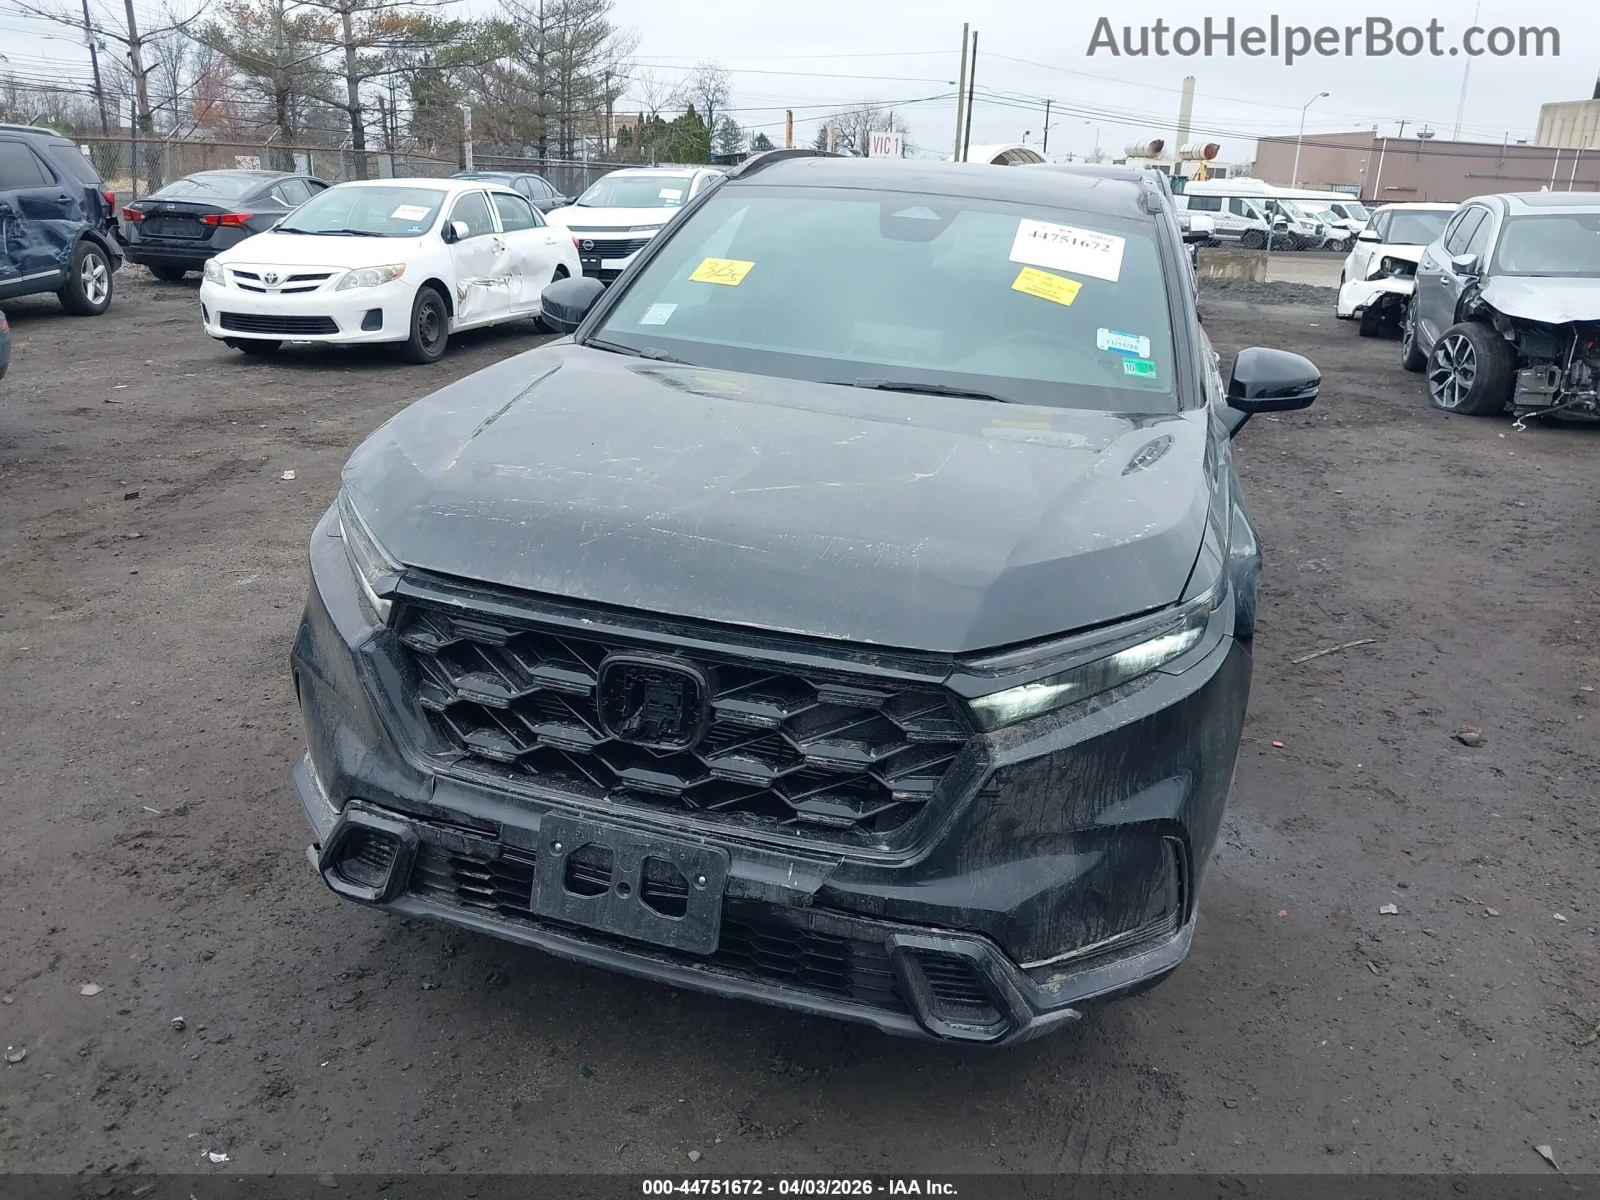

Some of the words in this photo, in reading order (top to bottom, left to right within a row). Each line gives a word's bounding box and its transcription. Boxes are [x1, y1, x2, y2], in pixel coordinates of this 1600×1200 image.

[873, 136, 891, 155] VIC
[894, 137, 899, 155] 1
[1028, 230, 1111, 253] 44751672
